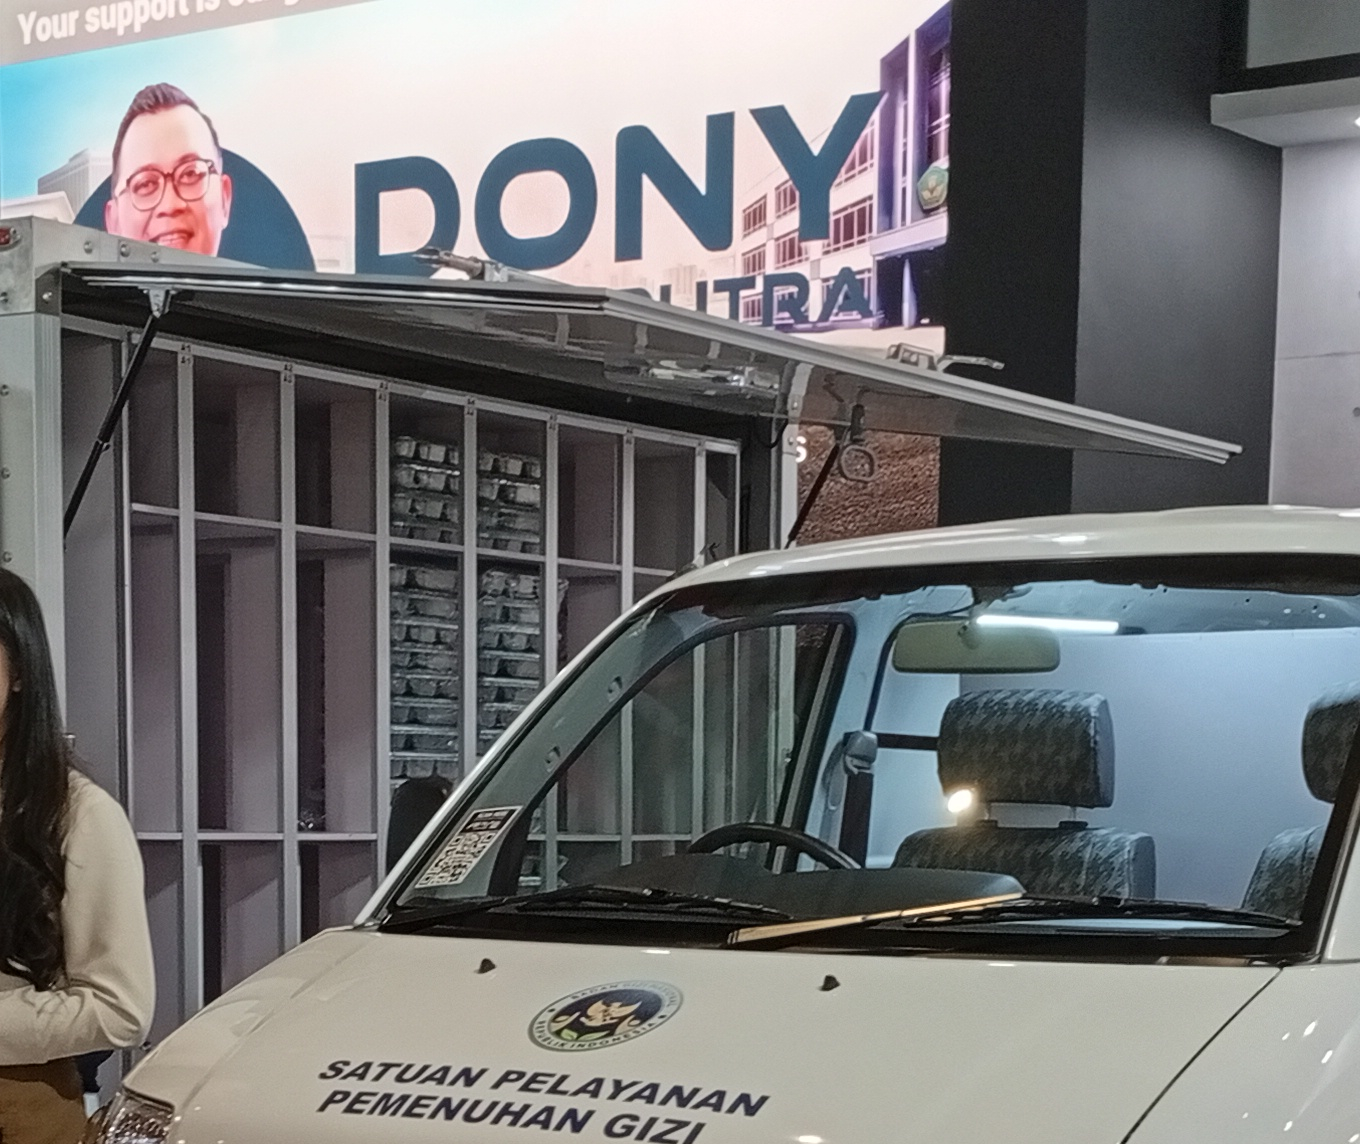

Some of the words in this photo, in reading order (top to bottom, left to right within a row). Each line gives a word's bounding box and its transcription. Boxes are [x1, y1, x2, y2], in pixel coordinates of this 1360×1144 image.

[17, 8, 80, 45] Your
[85, 0, 189, 36] support
[353, 90, 884, 275] DONY
[316, 1089, 595, 1135] PEMENUHAN
[318, 1059, 488, 1090] SATUAN
[490, 1069, 770, 1118] PELAYANAN
